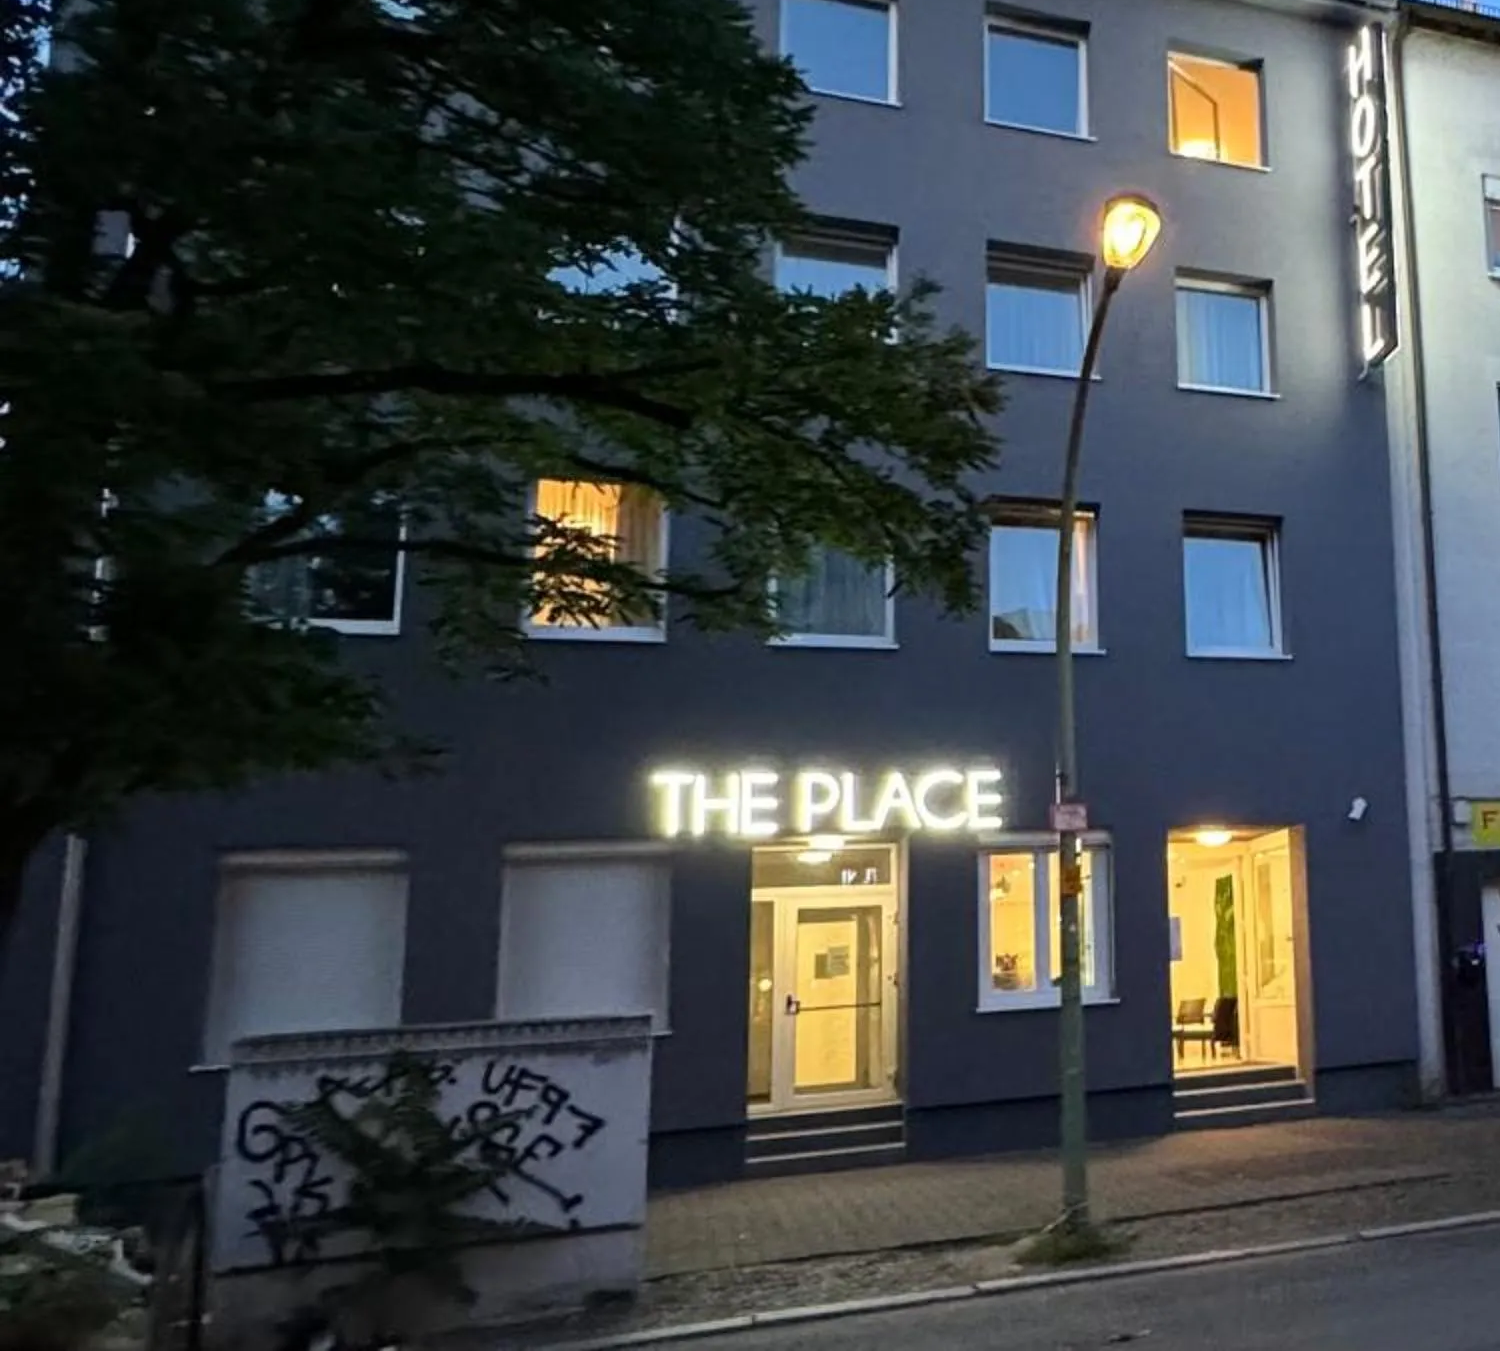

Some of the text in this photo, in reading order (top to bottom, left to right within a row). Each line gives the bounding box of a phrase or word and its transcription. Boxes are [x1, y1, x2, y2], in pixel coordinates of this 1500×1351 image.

[1349, 25, 1386, 361] HOTEL
[652, 768, 1003, 837] THE PLACE
